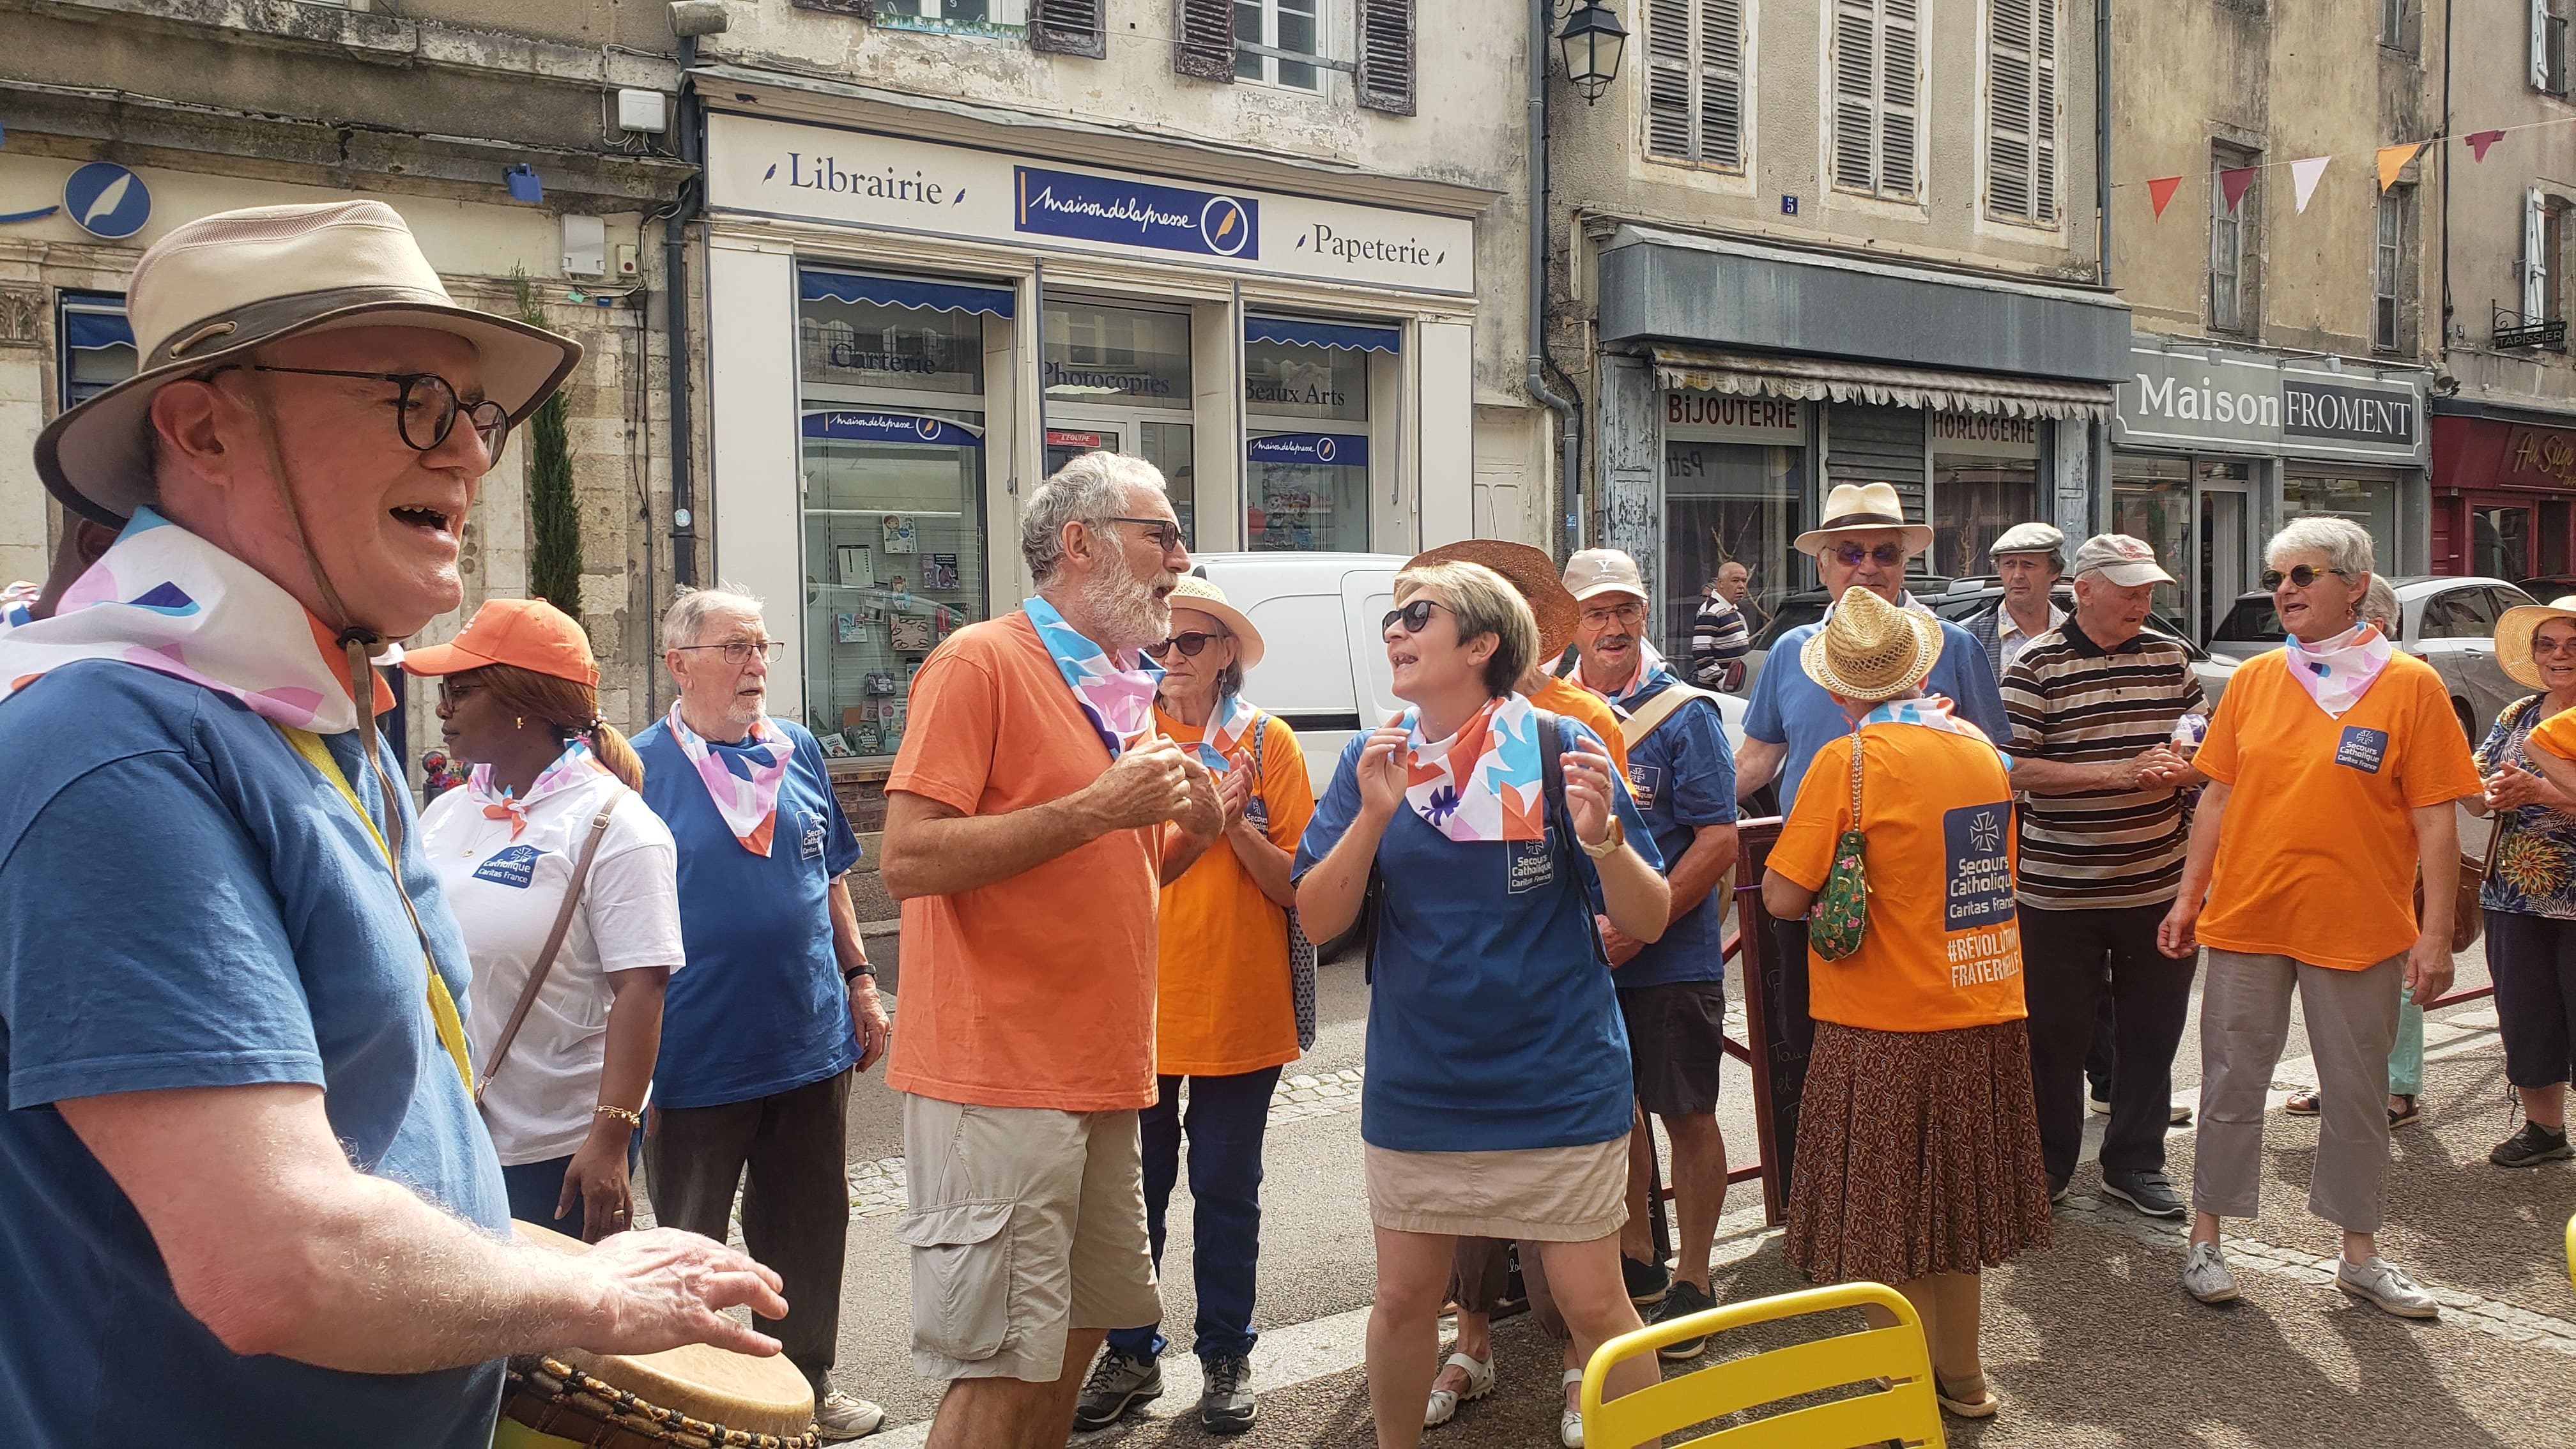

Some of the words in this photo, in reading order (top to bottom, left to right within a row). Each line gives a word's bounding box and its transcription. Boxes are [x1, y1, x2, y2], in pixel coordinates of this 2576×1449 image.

[787, 152, 942, 204] Librairie
[1787, 197, 1794, 213] 5
[1312, 223, 1430, 266] Papeterie
[2498, 331, 2562, 347] TAPISSIER
[831, 343, 936, 374] Carterie
[1045, 362, 1170, 395] Photocopies
[1245, 378, 1300, 403] Beaux
[1304, 383, 1346, 406] Arts
[2136, 373, 2280, 427] Maison
[2285, 390, 2411, 436] FROMENT
[2340, 746, 2380, 763] Catholique
[2345, 741, 2377, 755] Secours
[478, 868, 502, 878] Caritas
[503, 871, 528, 883] France
[1512, 861, 1551, 877] Catholique
[1958, 856, 2009, 877] Secours
[1951, 872, 2012, 897] Catholiqu
[1950, 900, 1989, 919] Caritas
